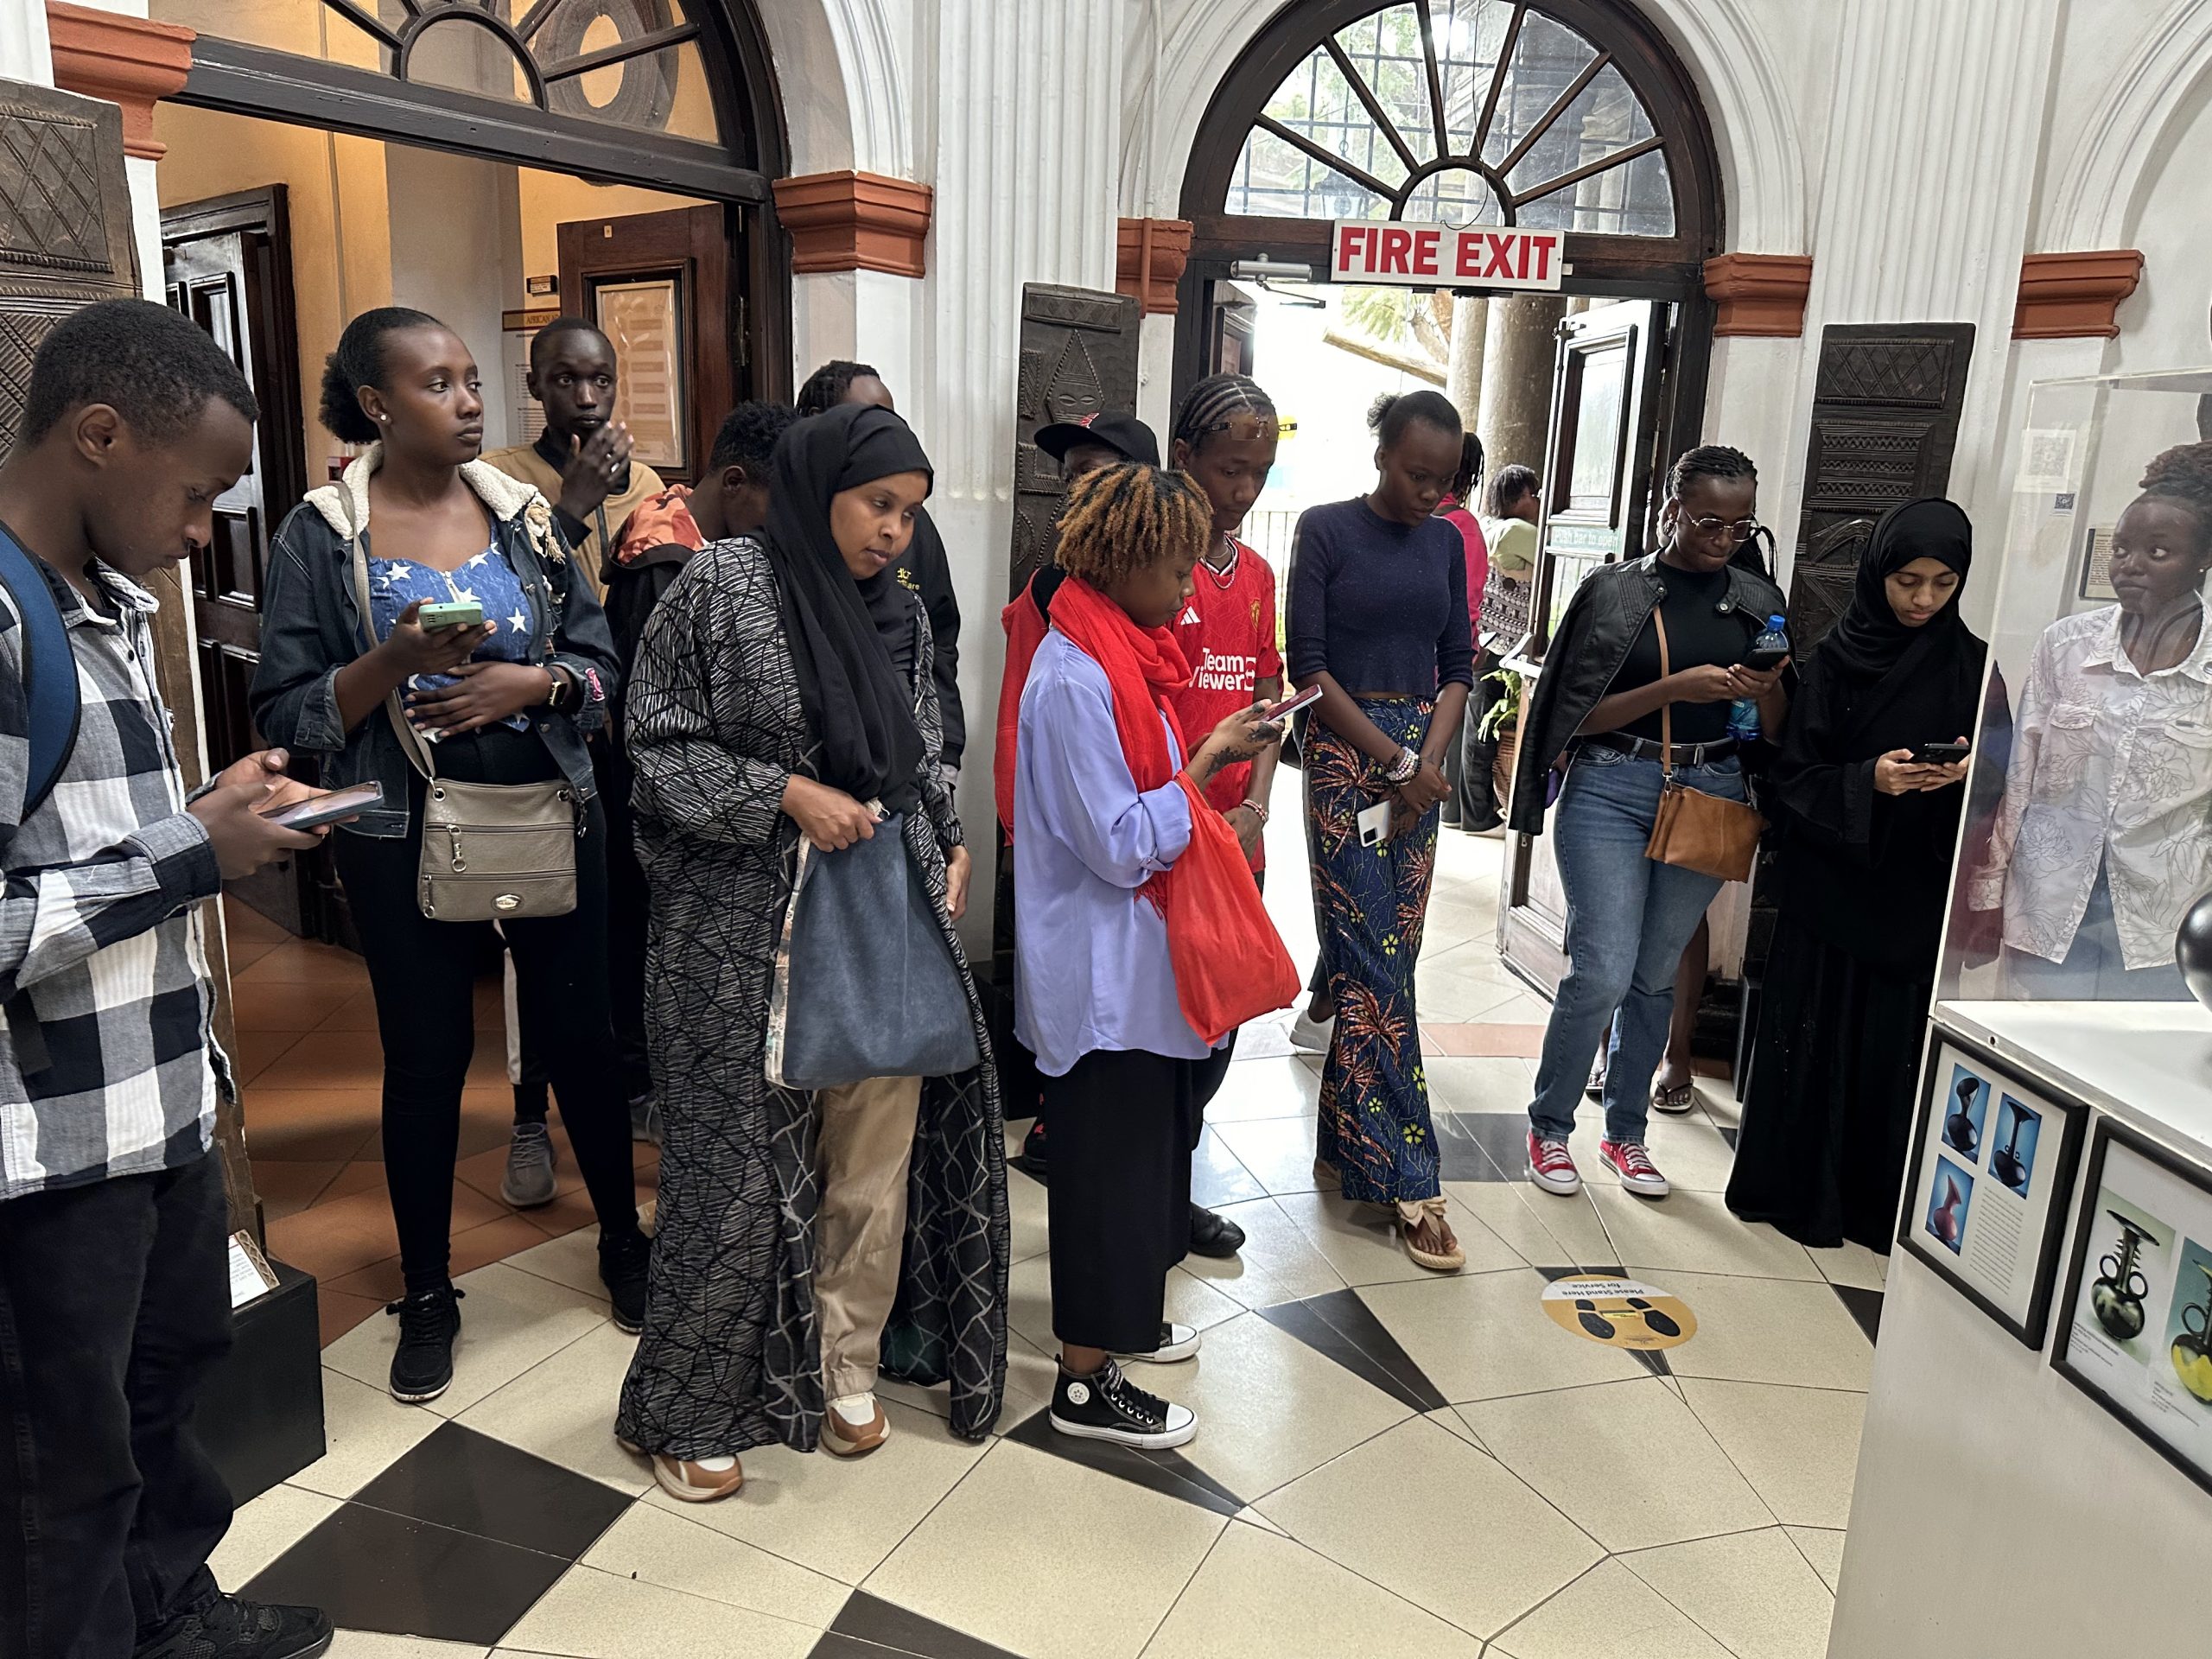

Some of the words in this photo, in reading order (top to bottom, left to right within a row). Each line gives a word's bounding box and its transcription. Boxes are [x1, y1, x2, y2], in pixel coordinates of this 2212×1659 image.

[1338, 226, 1440, 276] FIRE
[1455, 232, 1556, 281] EXIT
[525, 315, 550, 324] AFRICAN
[1574, 529, 1587, 545] bar
[1588, 531, 1597, 546] to
[1599, 534, 1618, 549] open
[1202, 647, 1244, 672] Team
